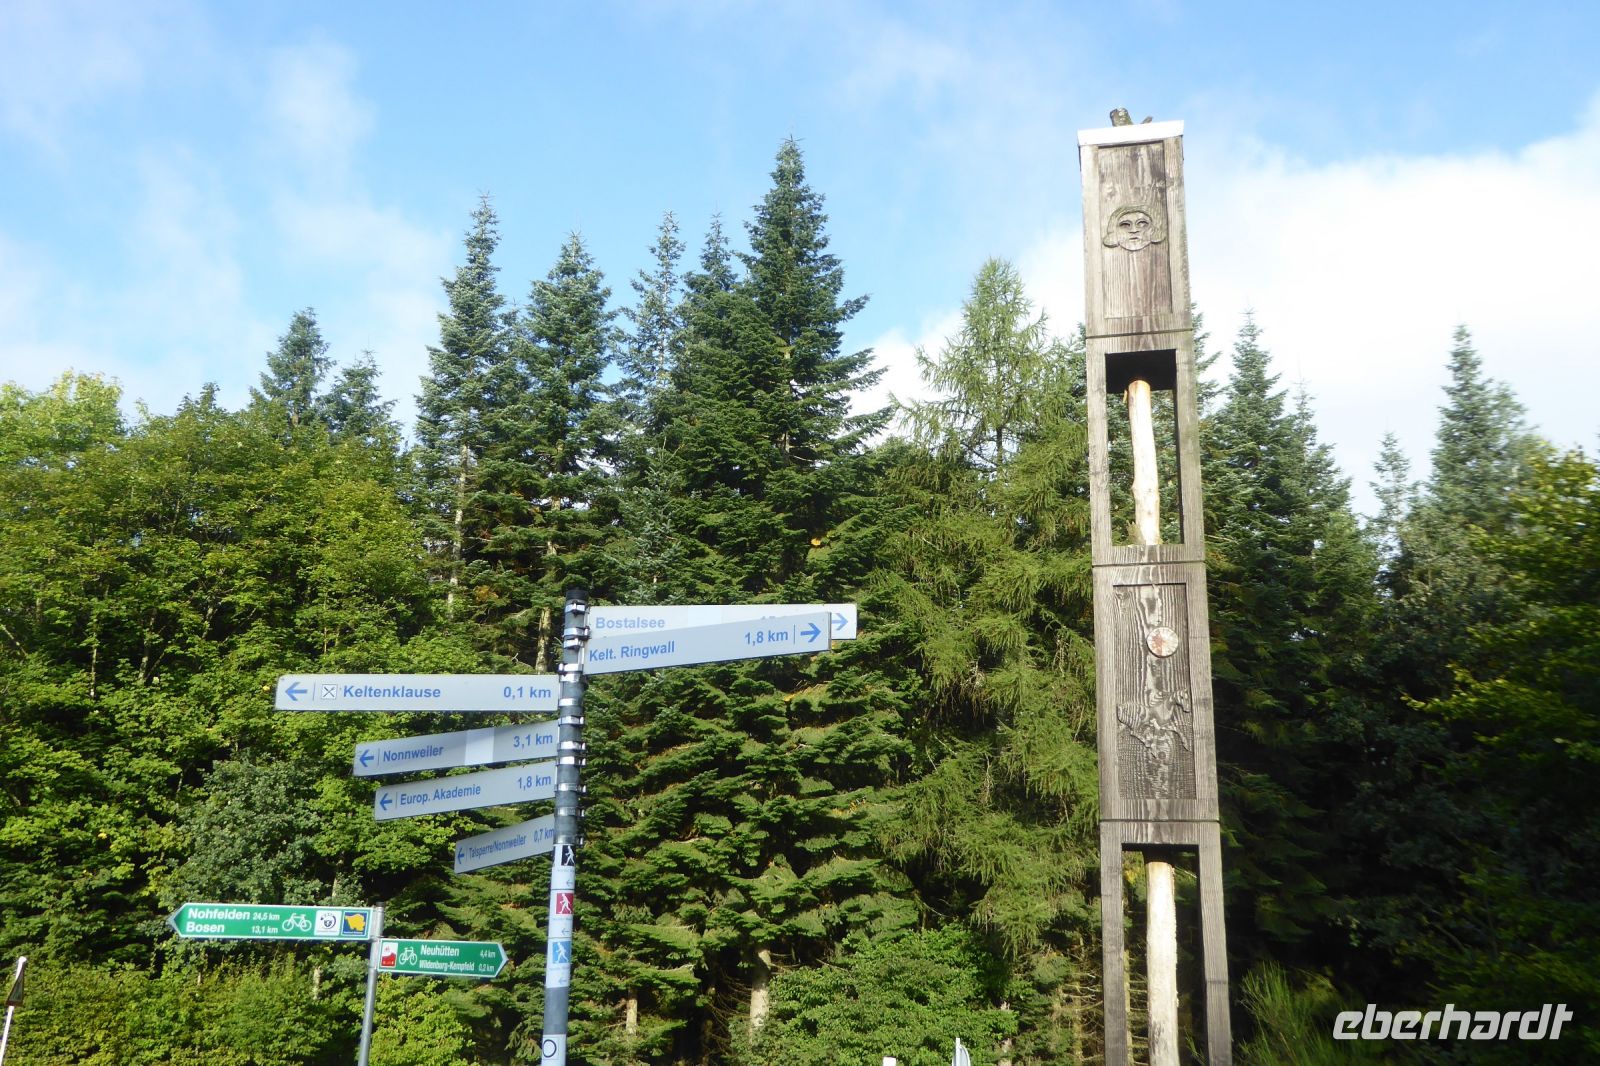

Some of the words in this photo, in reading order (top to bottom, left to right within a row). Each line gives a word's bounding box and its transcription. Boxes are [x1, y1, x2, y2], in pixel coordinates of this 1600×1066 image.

[595, 616, 666, 630] Bostalsee
[589, 648, 617, 662] Kelt.
[620, 641, 675, 659] Ringwall
[744, 629, 765, 646] 1,8
[768, 629, 789, 643] km
[343, 685, 441, 698] Keltenklause
[503, 686, 524, 700] 0,1
[529, 686, 552, 698] km
[383, 745, 444, 762] Nonnweiler
[513, 734, 531, 749] 3,1
[535, 733, 553, 745] km
[400, 793, 431, 806] Europ.
[433, 784, 481, 801] Akademie
[517, 777, 532, 791] 1,8
[535, 775, 552, 786] km
[533, 829, 543, 842] 0,7
[545, 827, 555, 839] km
[188, 908, 250, 920] Nohfelden
[252, 912, 268, 922] 24,5
[269, 913, 280, 921] km
[186, 921, 225, 933] Bosen
[251, 925, 266, 935] 13,1
[267, 926, 279, 934] km
[420, 944, 460, 956] Neuhütten
[488, 949, 496, 959] km
